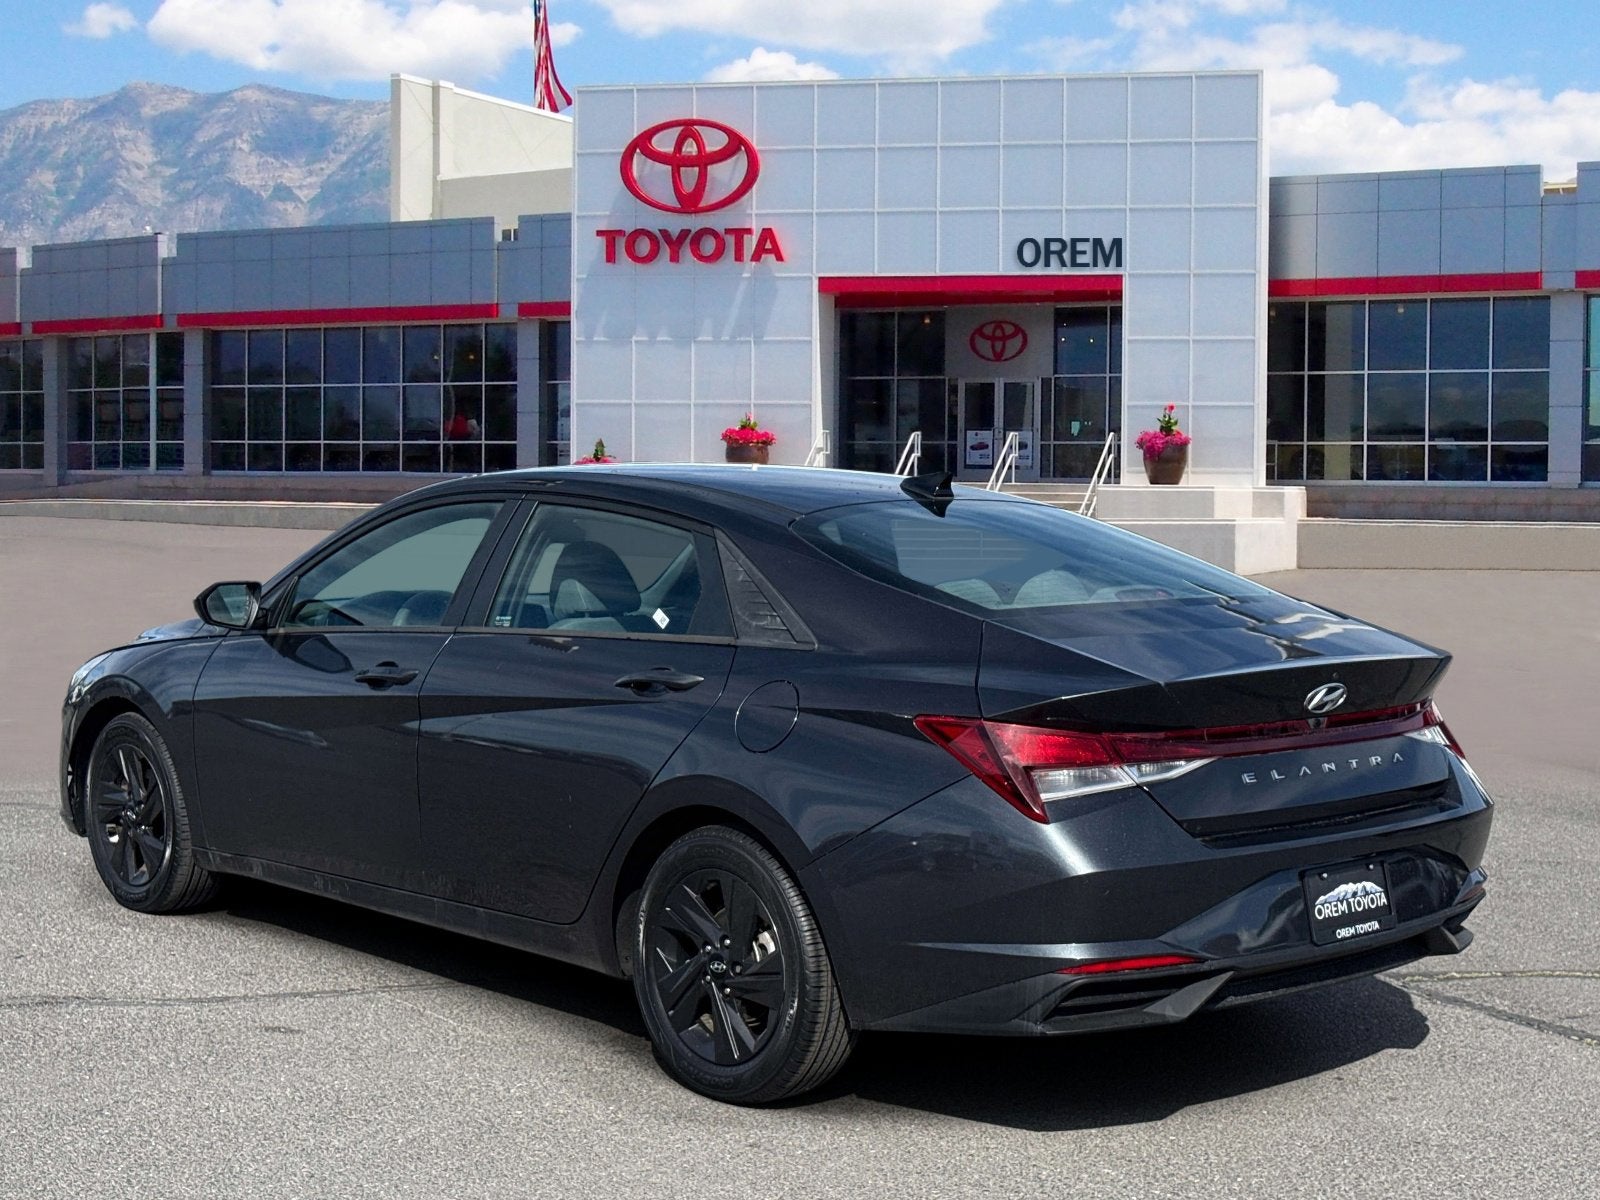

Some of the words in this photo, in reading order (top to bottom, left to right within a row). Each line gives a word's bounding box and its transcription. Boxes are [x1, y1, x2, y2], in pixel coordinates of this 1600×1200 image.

[596, 227, 785, 265] TOYOTA
[1016, 237, 1123, 268] OREM
[1241, 752, 1404, 784] ELANTRA
[1315, 900, 1348, 919] OREM
[1348, 892, 1388, 912] TOYOTA
[1336, 925, 1355, 938] OREM
[1355, 921, 1380, 934] TOYOTA
